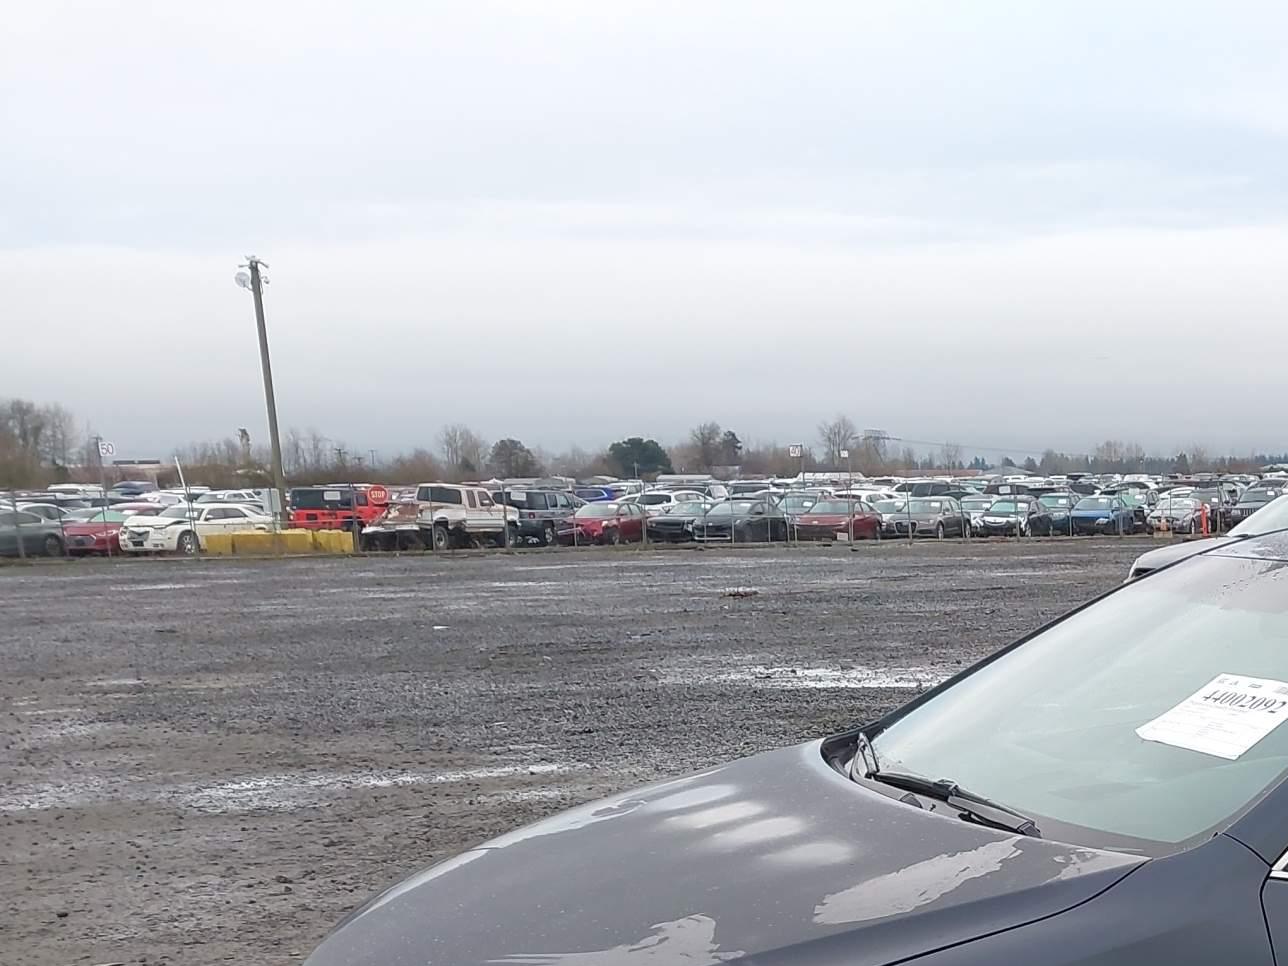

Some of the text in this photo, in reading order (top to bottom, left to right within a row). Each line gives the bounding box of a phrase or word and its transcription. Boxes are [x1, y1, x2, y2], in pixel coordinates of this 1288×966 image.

[100, 443, 114, 455] 50
[370, 490, 386, 499] STOP
[1202, 689, 1287, 714] 44002092
